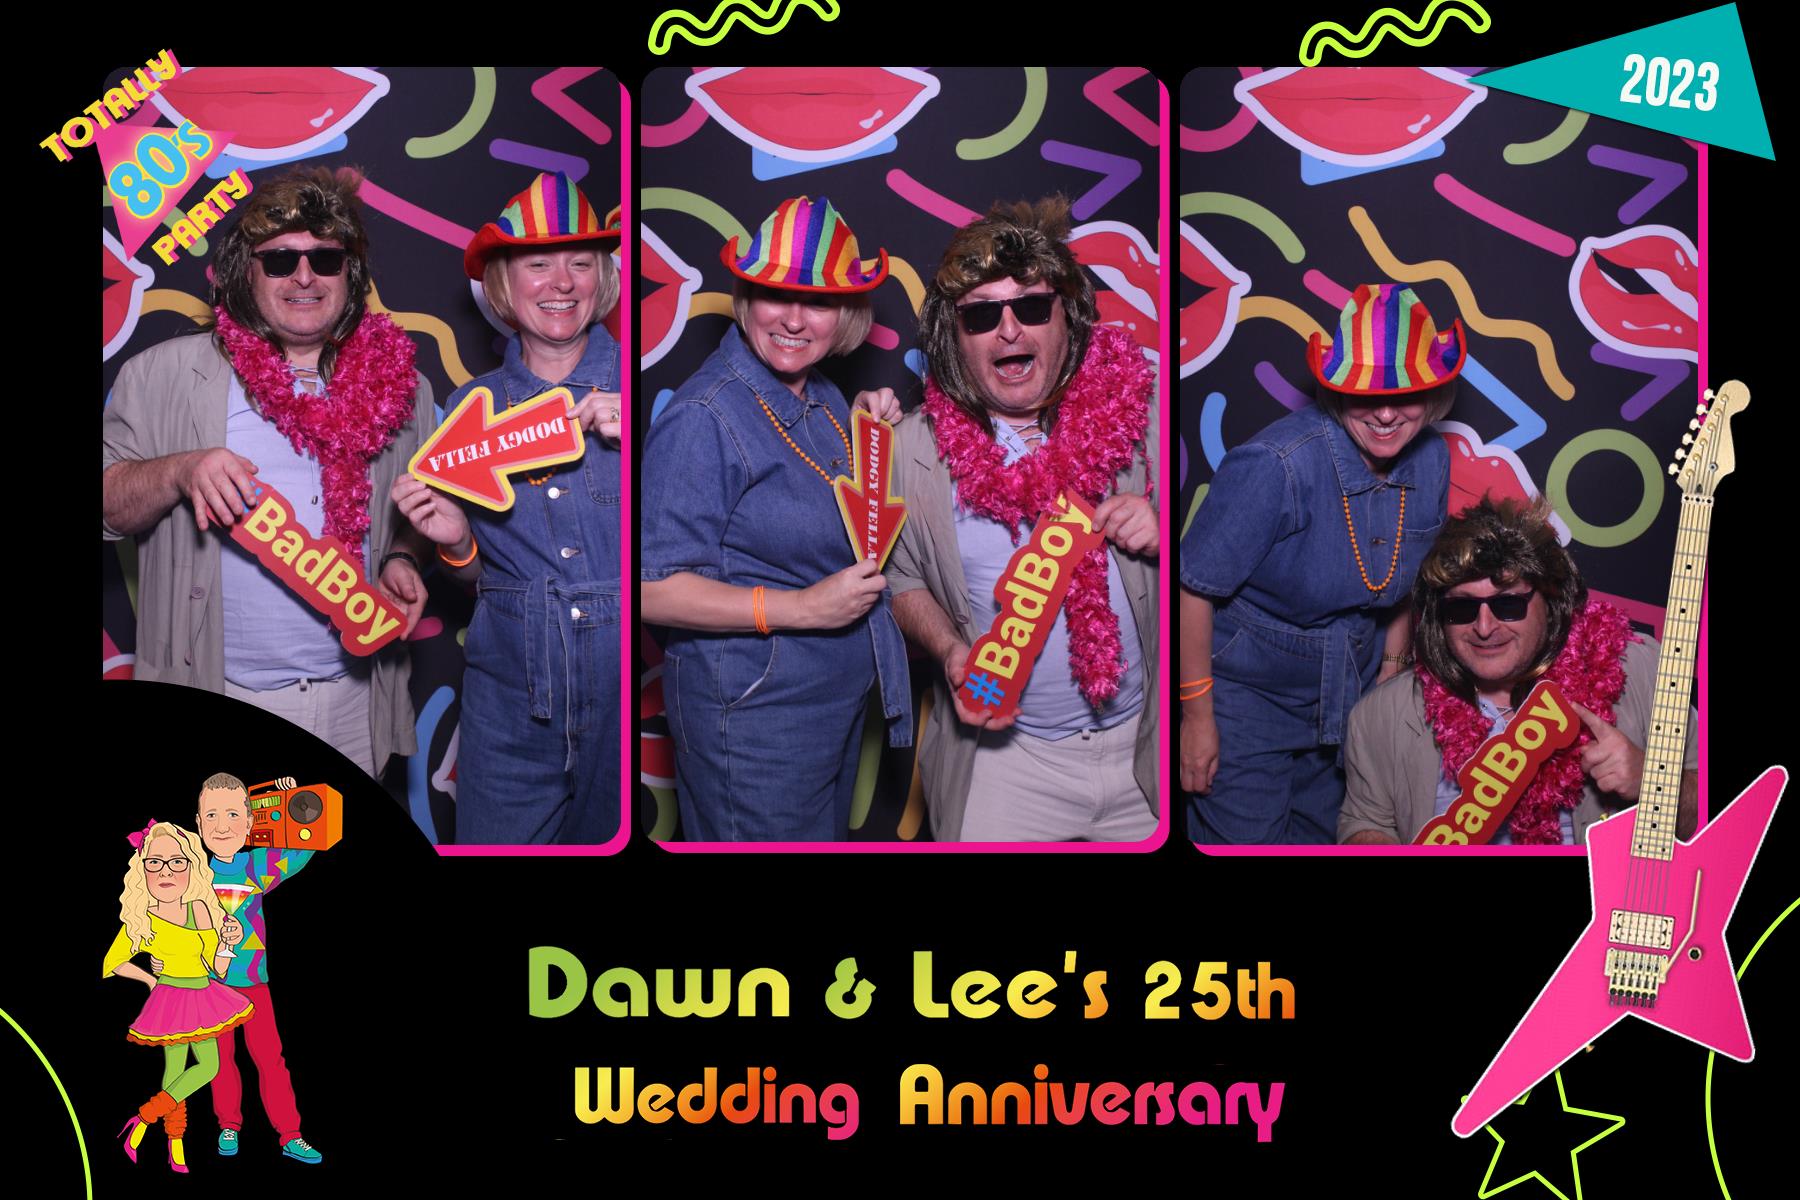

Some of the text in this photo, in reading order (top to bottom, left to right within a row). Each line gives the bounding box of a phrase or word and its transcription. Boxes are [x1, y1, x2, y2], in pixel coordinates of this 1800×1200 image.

[428, 416, 567, 473] DODGY FELLA
[867, 426, 880, 559] DODGY FELLA
[237, 482, 400, 645] BadBoy
[965, 493, 1092, 706] #BadBoy
